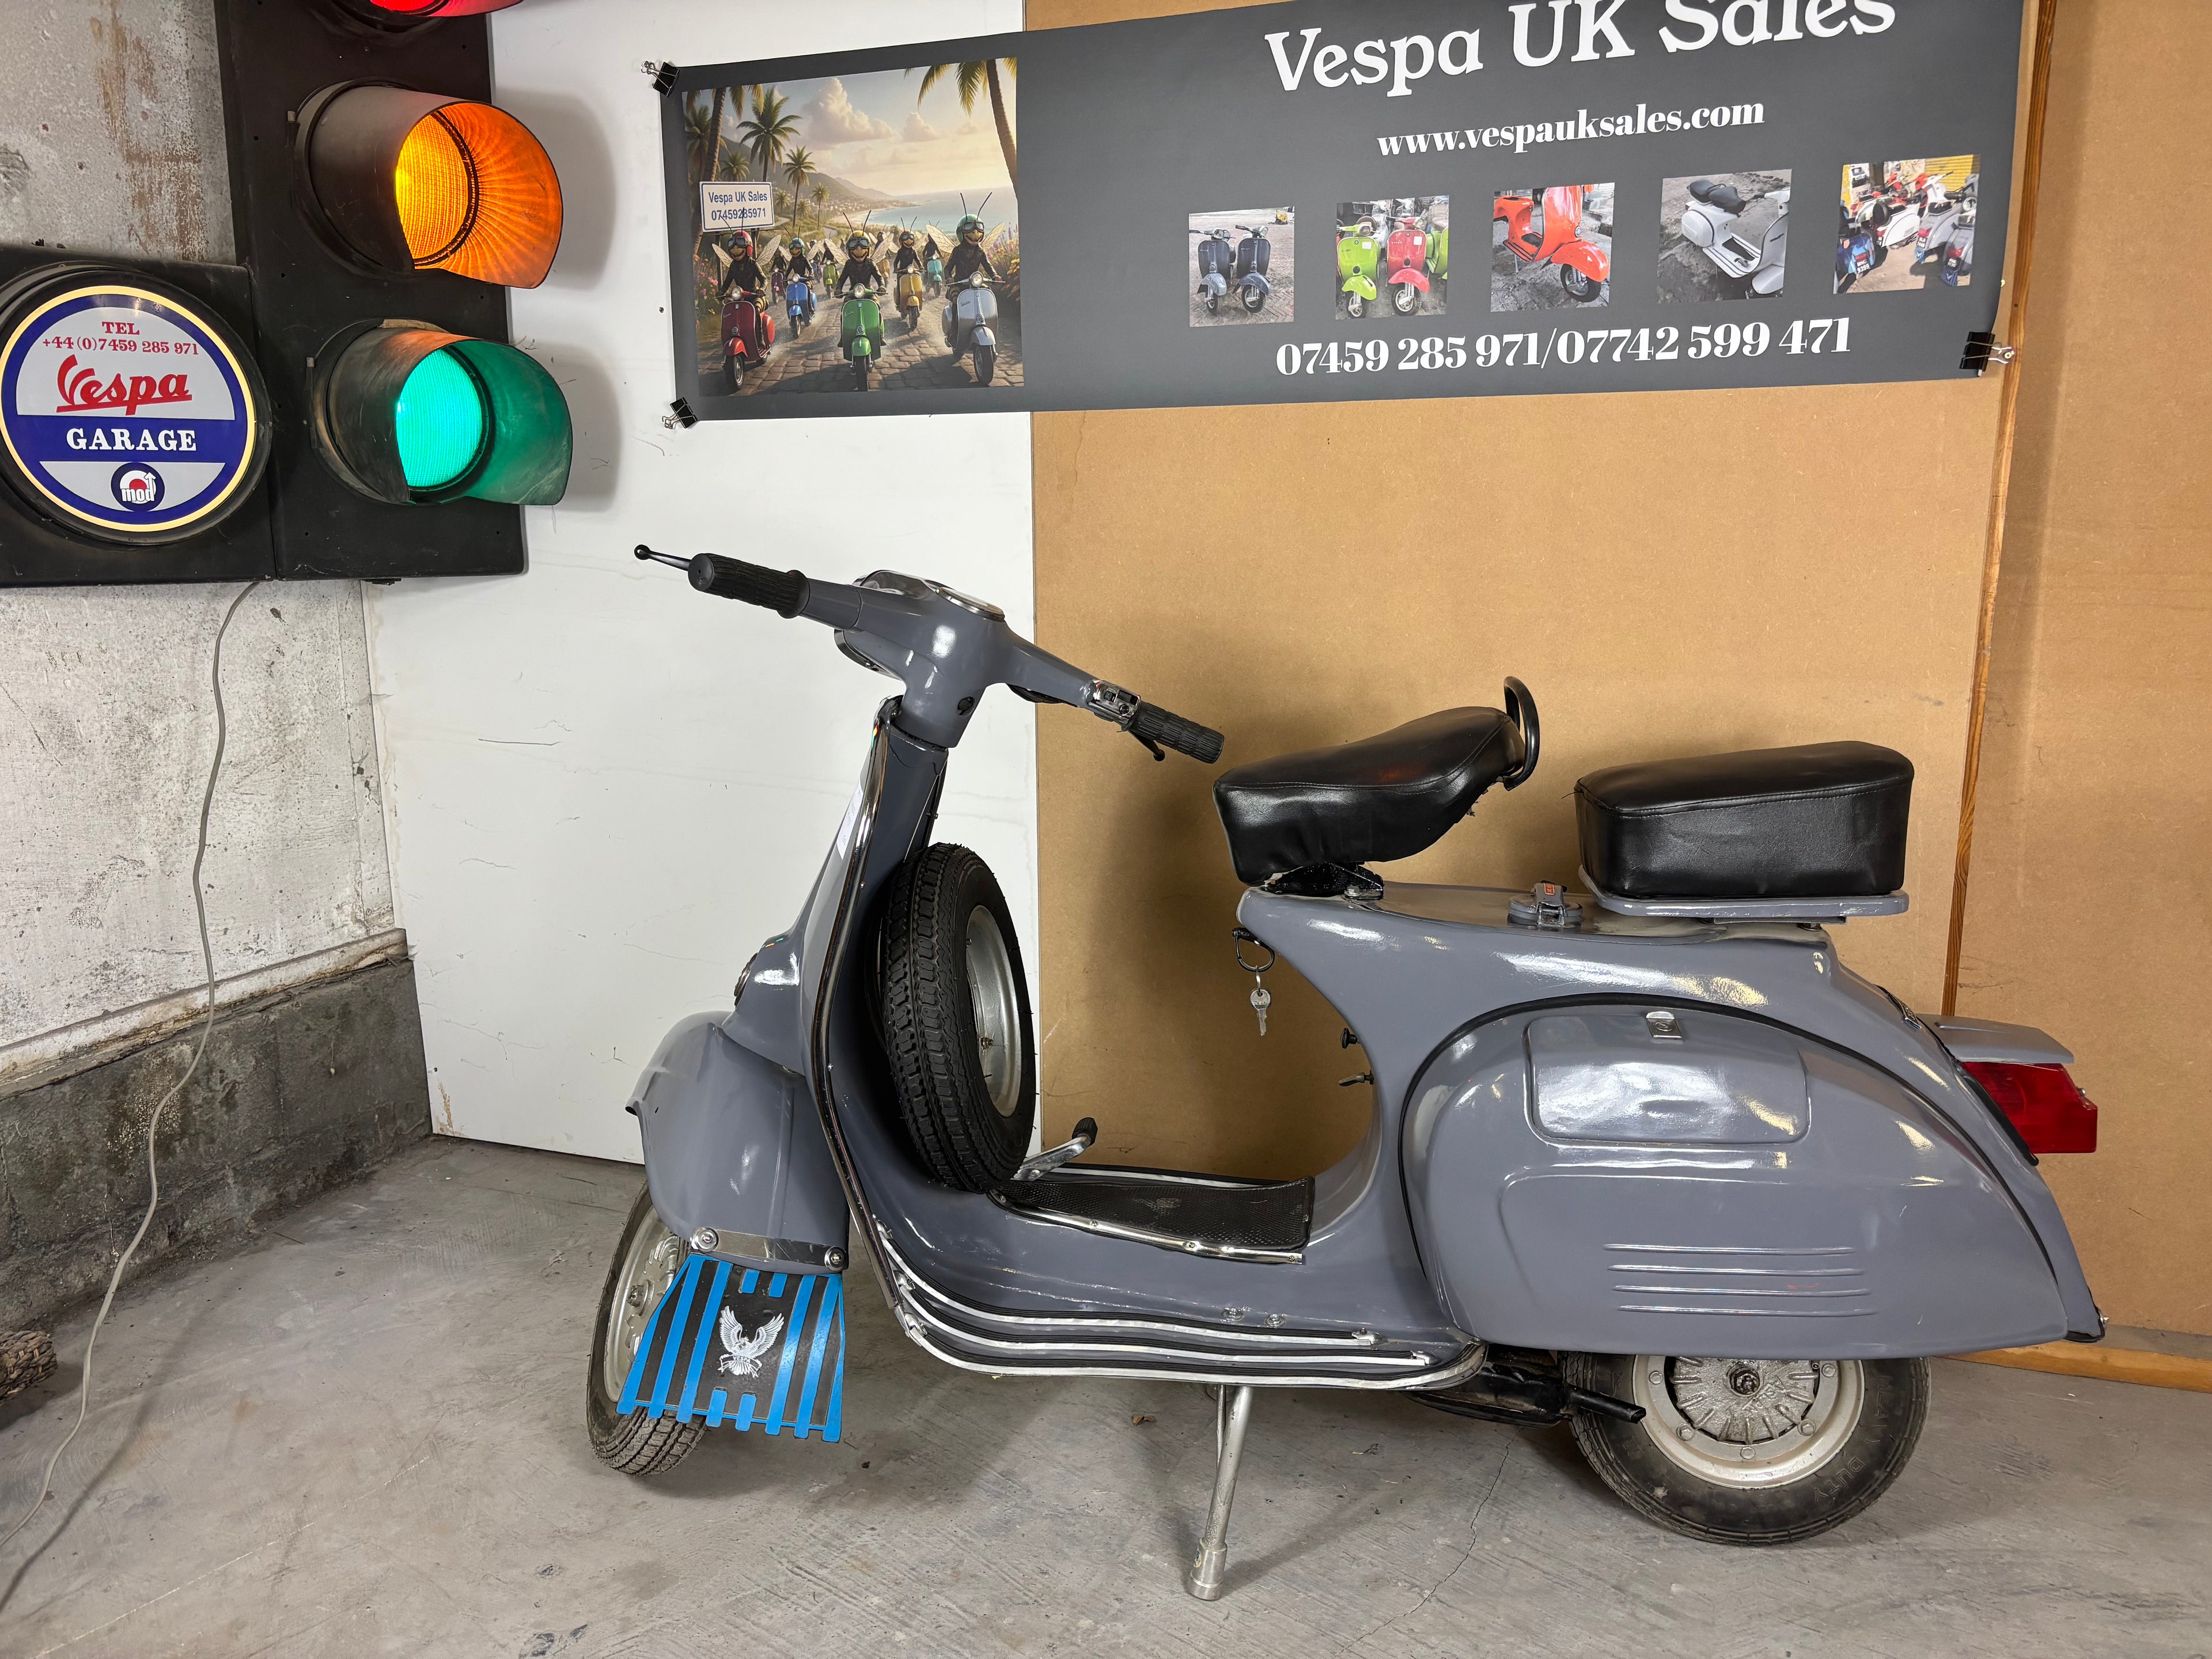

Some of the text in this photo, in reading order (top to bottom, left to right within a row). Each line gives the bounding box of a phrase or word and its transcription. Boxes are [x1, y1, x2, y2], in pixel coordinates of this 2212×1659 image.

[1264, 0, 1896, 98] Vespa UK Sales
[1376, 103, 1766, 157] www.vespauksales.com
[708, 191, 767, 206] Vespa UK Sales
[711, 207, 766, 221] 07459285971
[101, 321, 141, 336] TEL
[43, 336, 199, 355] +44(0)7459 285 971
[1275, 316, 1851, 376] 07459 285 971/07742 599 471
[56, 354, 193, 416] Vespa
[66, 427, 197, 452] GARAGE
[120, 478, 155, 502] mod
[732, 1355, 751, 1363] VESPA
[1813, 1456, 1866, 1504] DUTY
